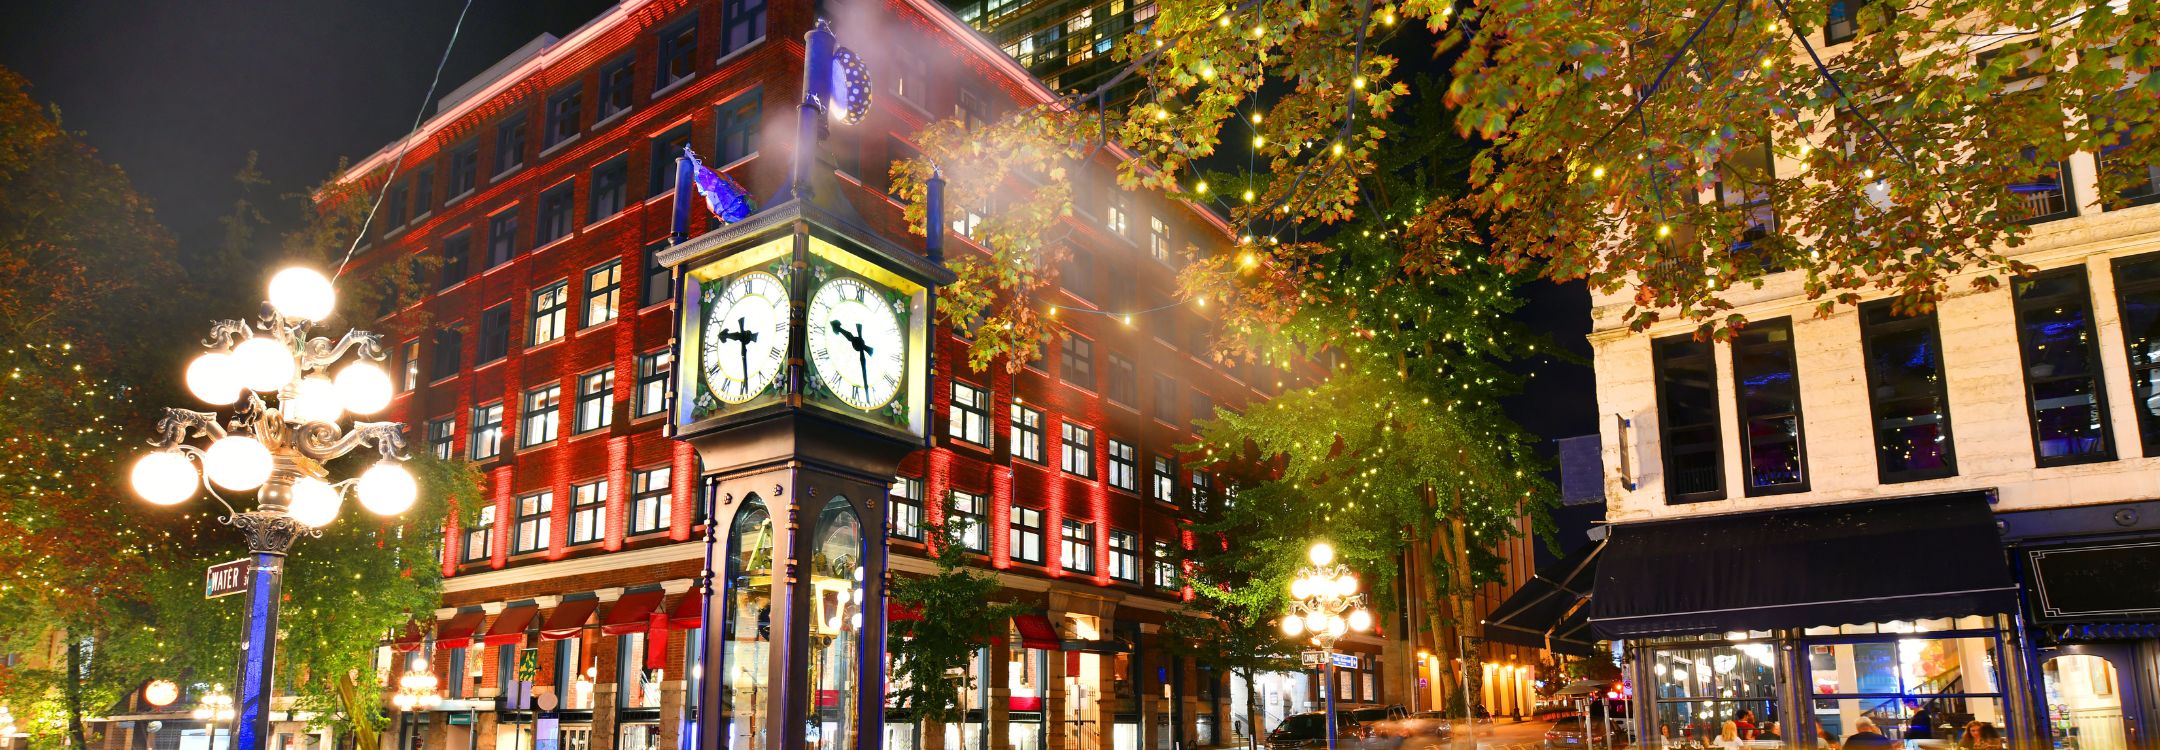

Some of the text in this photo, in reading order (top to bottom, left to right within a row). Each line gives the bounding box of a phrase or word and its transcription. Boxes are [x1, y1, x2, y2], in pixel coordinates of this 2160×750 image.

[743, 279, 753, 295] XII
[855, 285, 865, 304] XII
[775, 321, 786, 332] III
[769, 346, 781, 361] IIII
[211, 567, 239, 592] WATER
